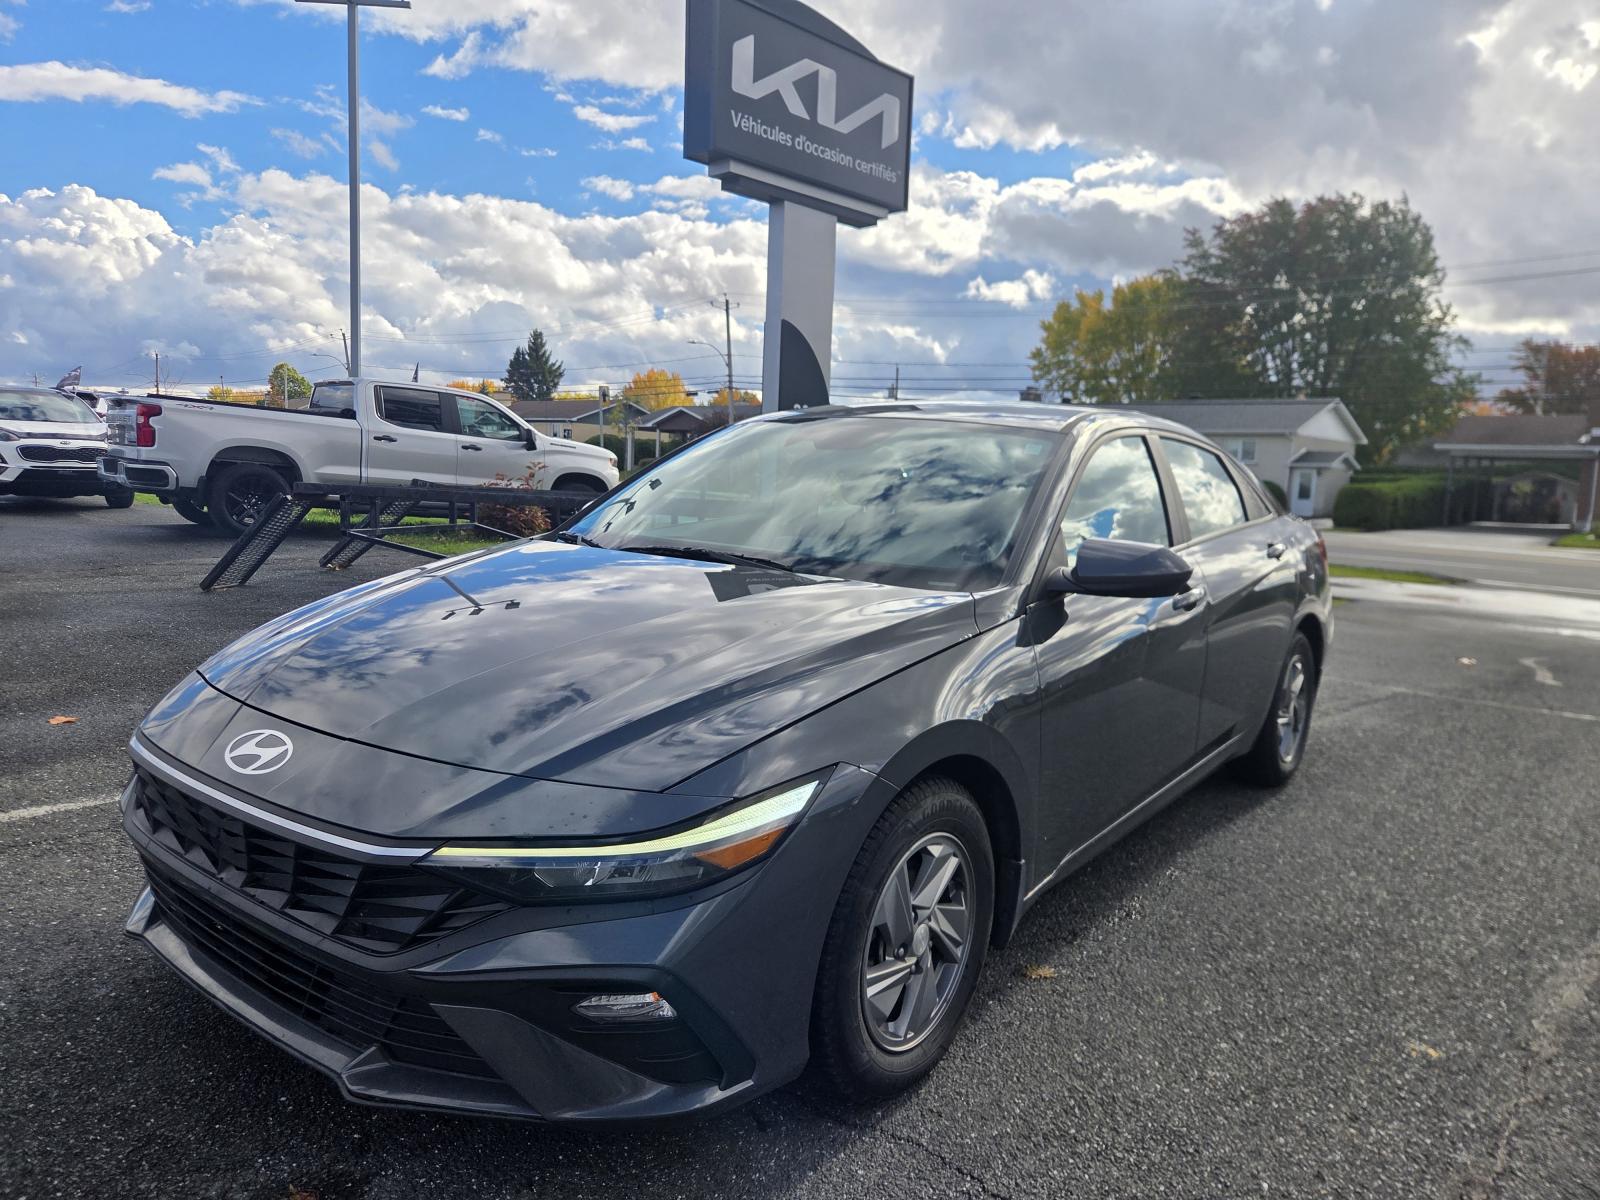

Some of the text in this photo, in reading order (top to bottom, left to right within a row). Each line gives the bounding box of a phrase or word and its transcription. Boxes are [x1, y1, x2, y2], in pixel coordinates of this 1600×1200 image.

[732, 34, 900, 149] KIA
[731, 110, 897, 184] Véhicules d'occasion certifiés
